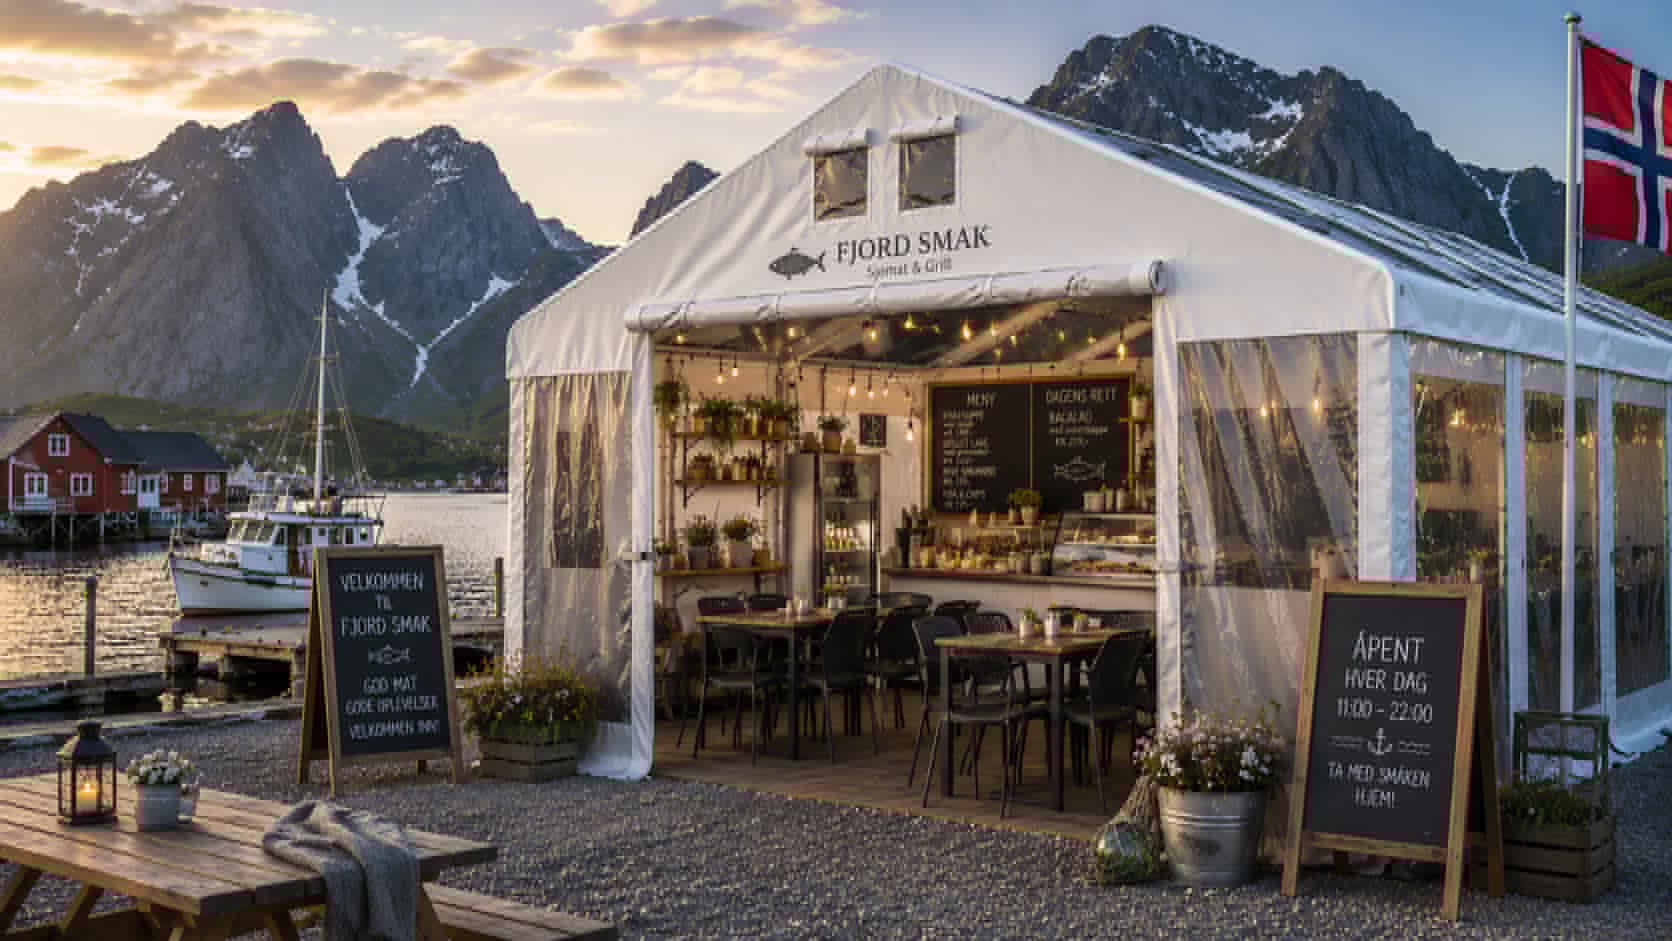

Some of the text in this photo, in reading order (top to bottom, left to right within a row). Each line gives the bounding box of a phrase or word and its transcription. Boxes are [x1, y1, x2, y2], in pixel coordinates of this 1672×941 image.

[837, 225, 992, 265] FJORD SMAK
[912, 260, 921, 274] &
[340, 571, 424, 592] VELKOMMEN
[375, 594, 392, 611] TIL
[341, 615, 432, 636] FJORD SMAK
[1351, 628, 1425, 664] ÅPENT
[363, 674, 417, 694] GOD MAT
[1344, 668, 1428, 694] HVER DAG
[1336, 698, 1372, 719] 11:00
[1389, 702, 1433, 724] 22:00
[1327, 761, 1344, 778] TA
[1347, 763, 1375, 782] MED
